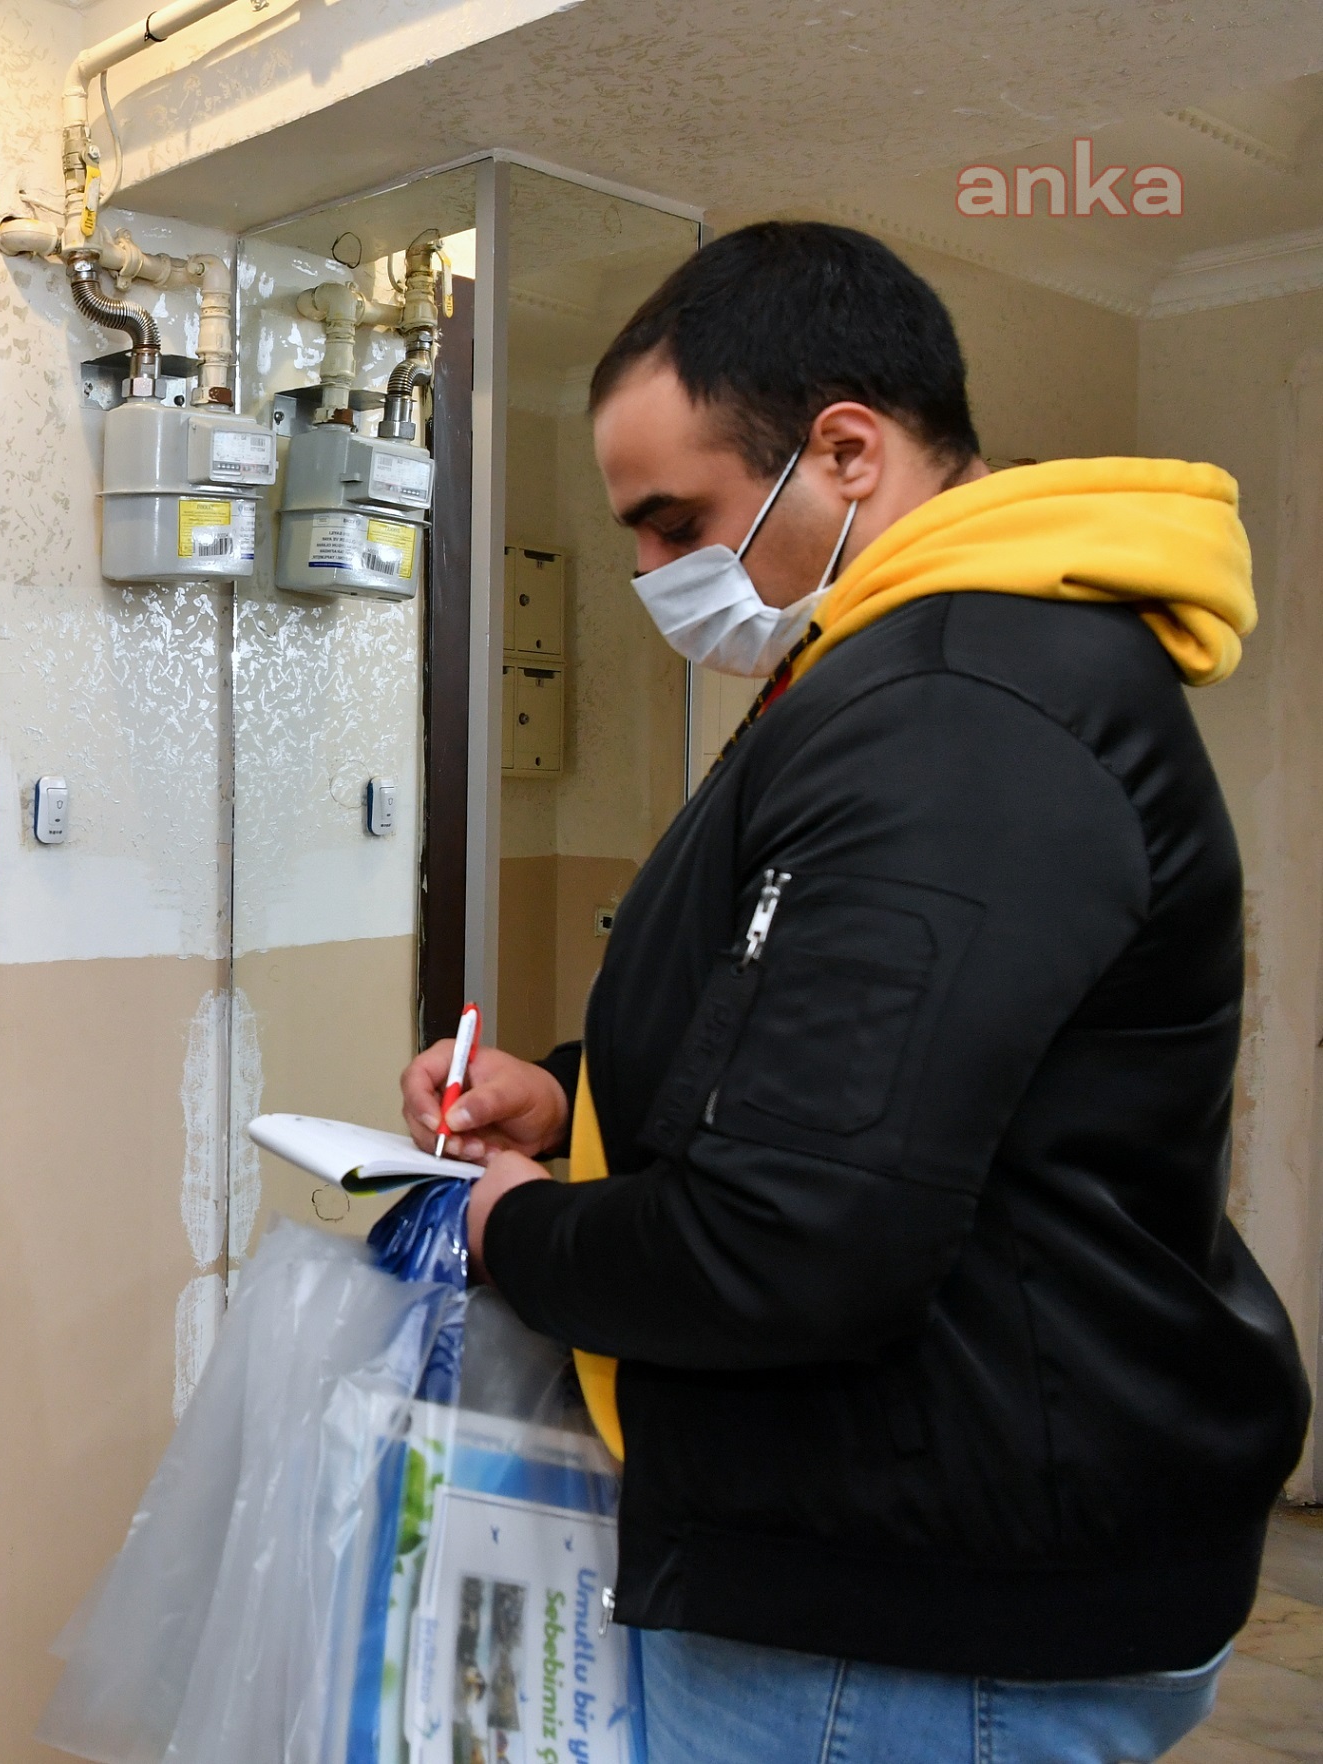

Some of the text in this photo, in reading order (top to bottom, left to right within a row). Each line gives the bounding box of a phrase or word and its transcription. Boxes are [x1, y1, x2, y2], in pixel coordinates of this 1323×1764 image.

[543, 1588, 565, 1739] Sebebimiz
[574, 1567, 597, 1684] Umutlu
[574, 1690, 596, 1733] bir
